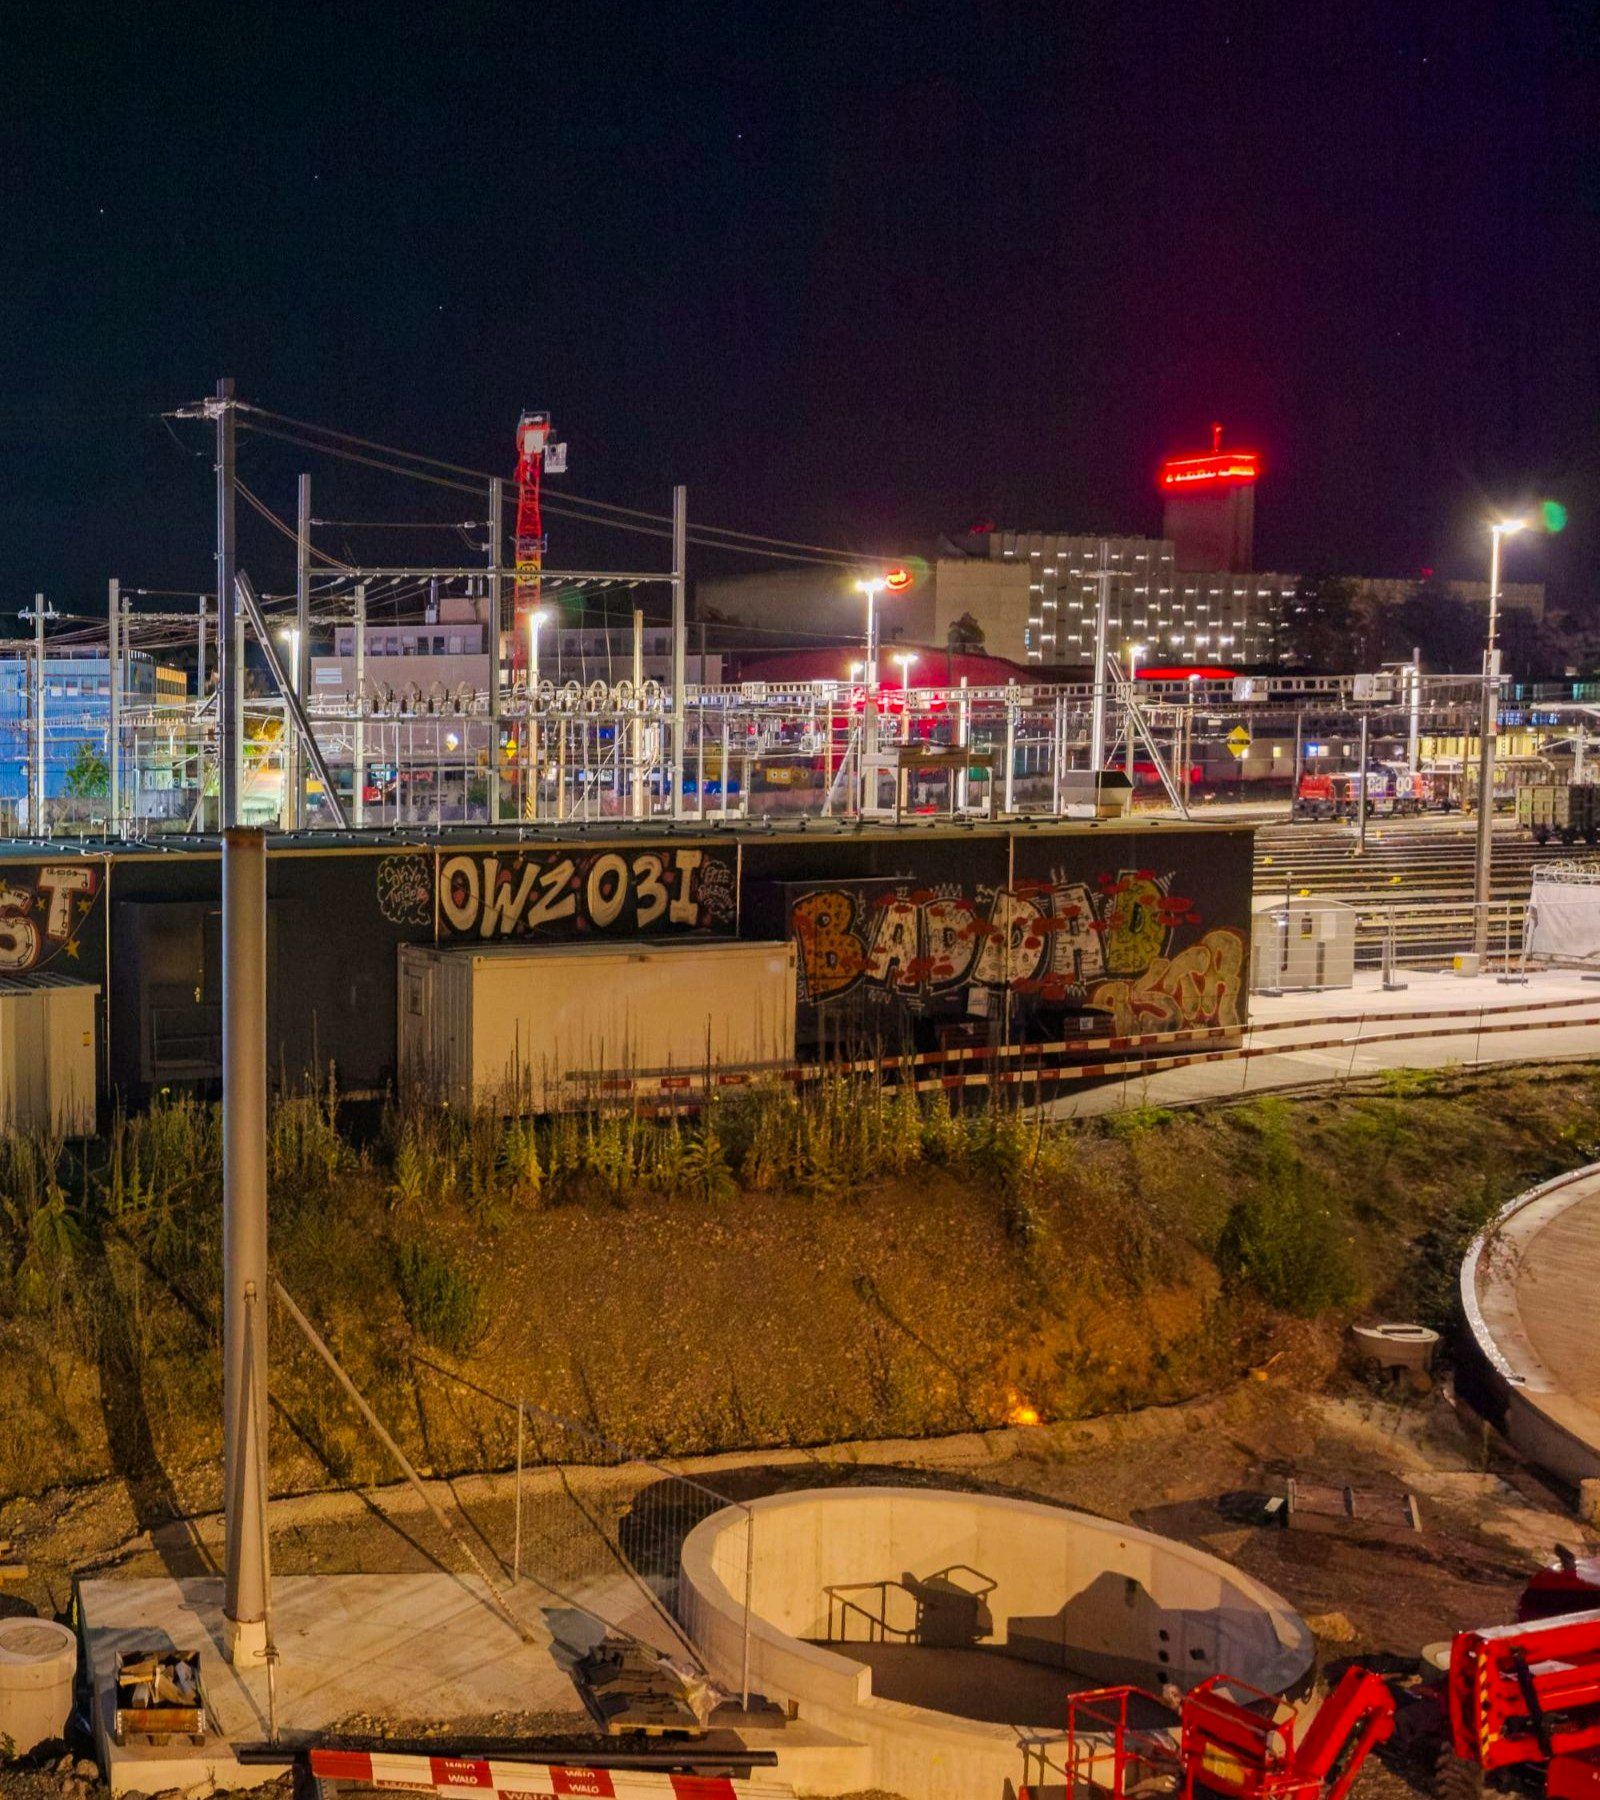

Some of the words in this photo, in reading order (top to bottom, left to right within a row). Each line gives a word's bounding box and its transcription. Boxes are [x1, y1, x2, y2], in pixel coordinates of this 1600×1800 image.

[1117, 684, 1132, 702] 437
[448, 1774, 478, 1785] WALO
[569, 1783, 600, 1794] WALO
